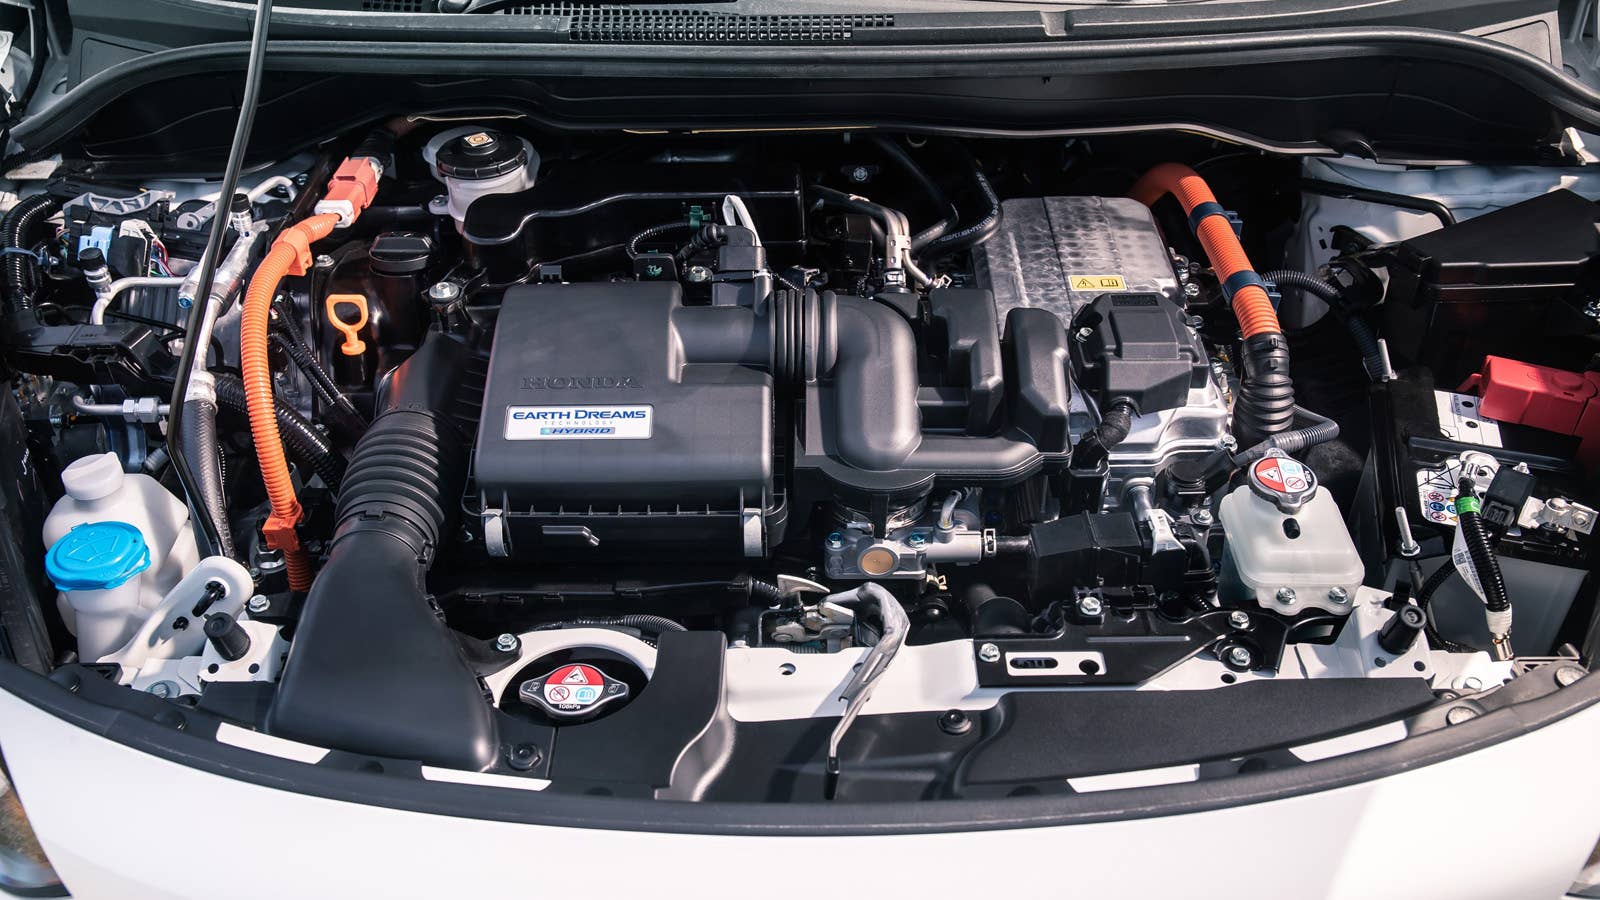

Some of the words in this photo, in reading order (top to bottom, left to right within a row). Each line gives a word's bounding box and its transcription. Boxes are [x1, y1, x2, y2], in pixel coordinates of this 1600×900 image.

[519, 376, 644, 390] HONDA
[513, 411, 571, 420] EARTH
[574, 409, 646, 419] DREAMS
